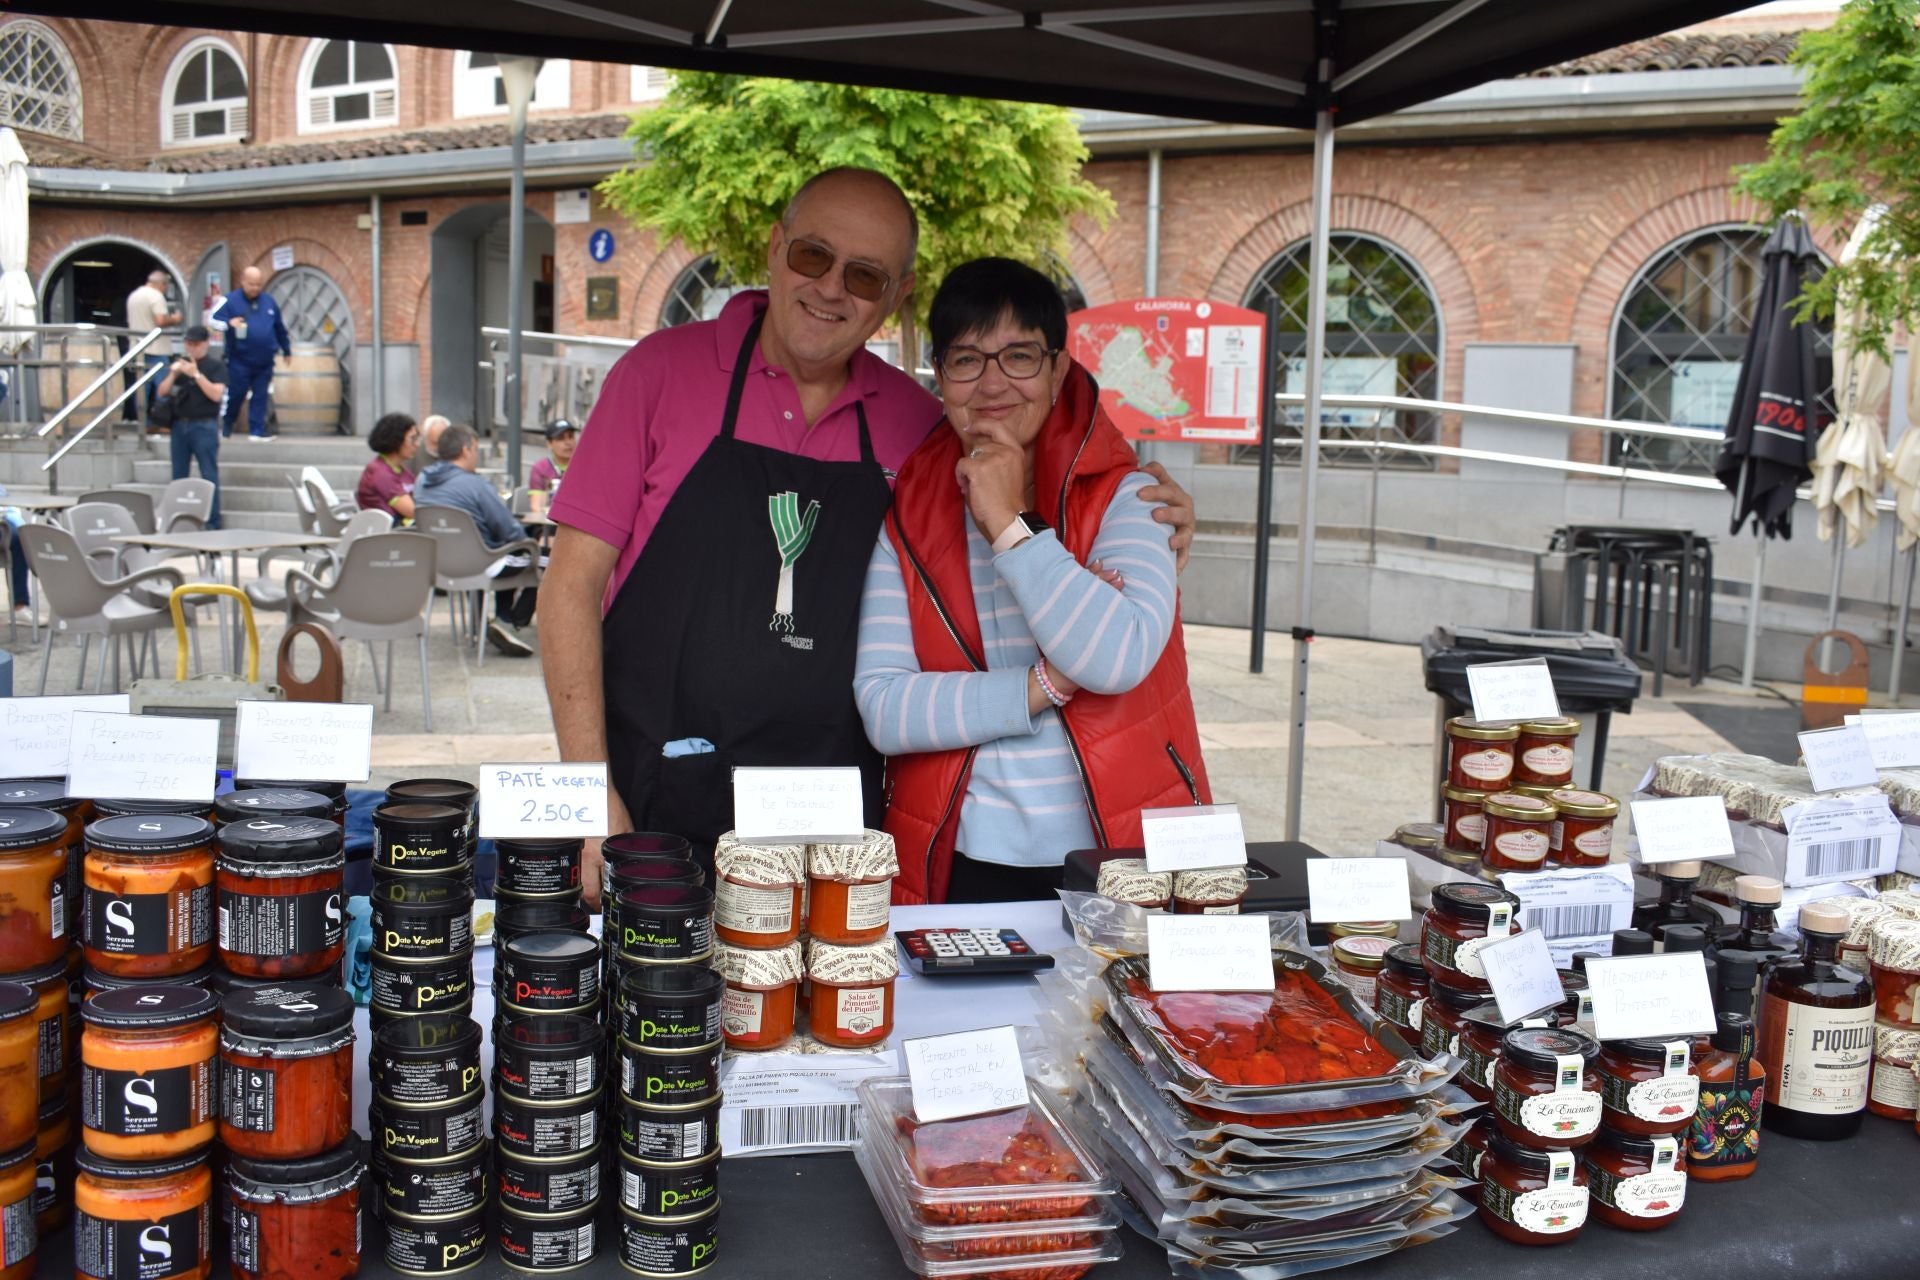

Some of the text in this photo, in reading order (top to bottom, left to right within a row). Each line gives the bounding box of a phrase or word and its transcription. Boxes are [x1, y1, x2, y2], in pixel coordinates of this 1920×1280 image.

[1134, 302, 1191, 312] CALAHORRA
[497, 767, 607, 788] PATÉ VEGETAL
[106, 900, 135, 936] S
[106, 935, 135, 943] Serrano
[847, 993, 866, 1001] Salsa
[844, 998, 879, 1008] Pimientos
[729, 1007, 757, 1016] Piquillo
[841, 1004, 881, 1014] del Piquillo
[124, 1078, 158, 1115] S
[139, 1224, 172, 1262] S
[140, 1261, 172, 1270] Serrano
